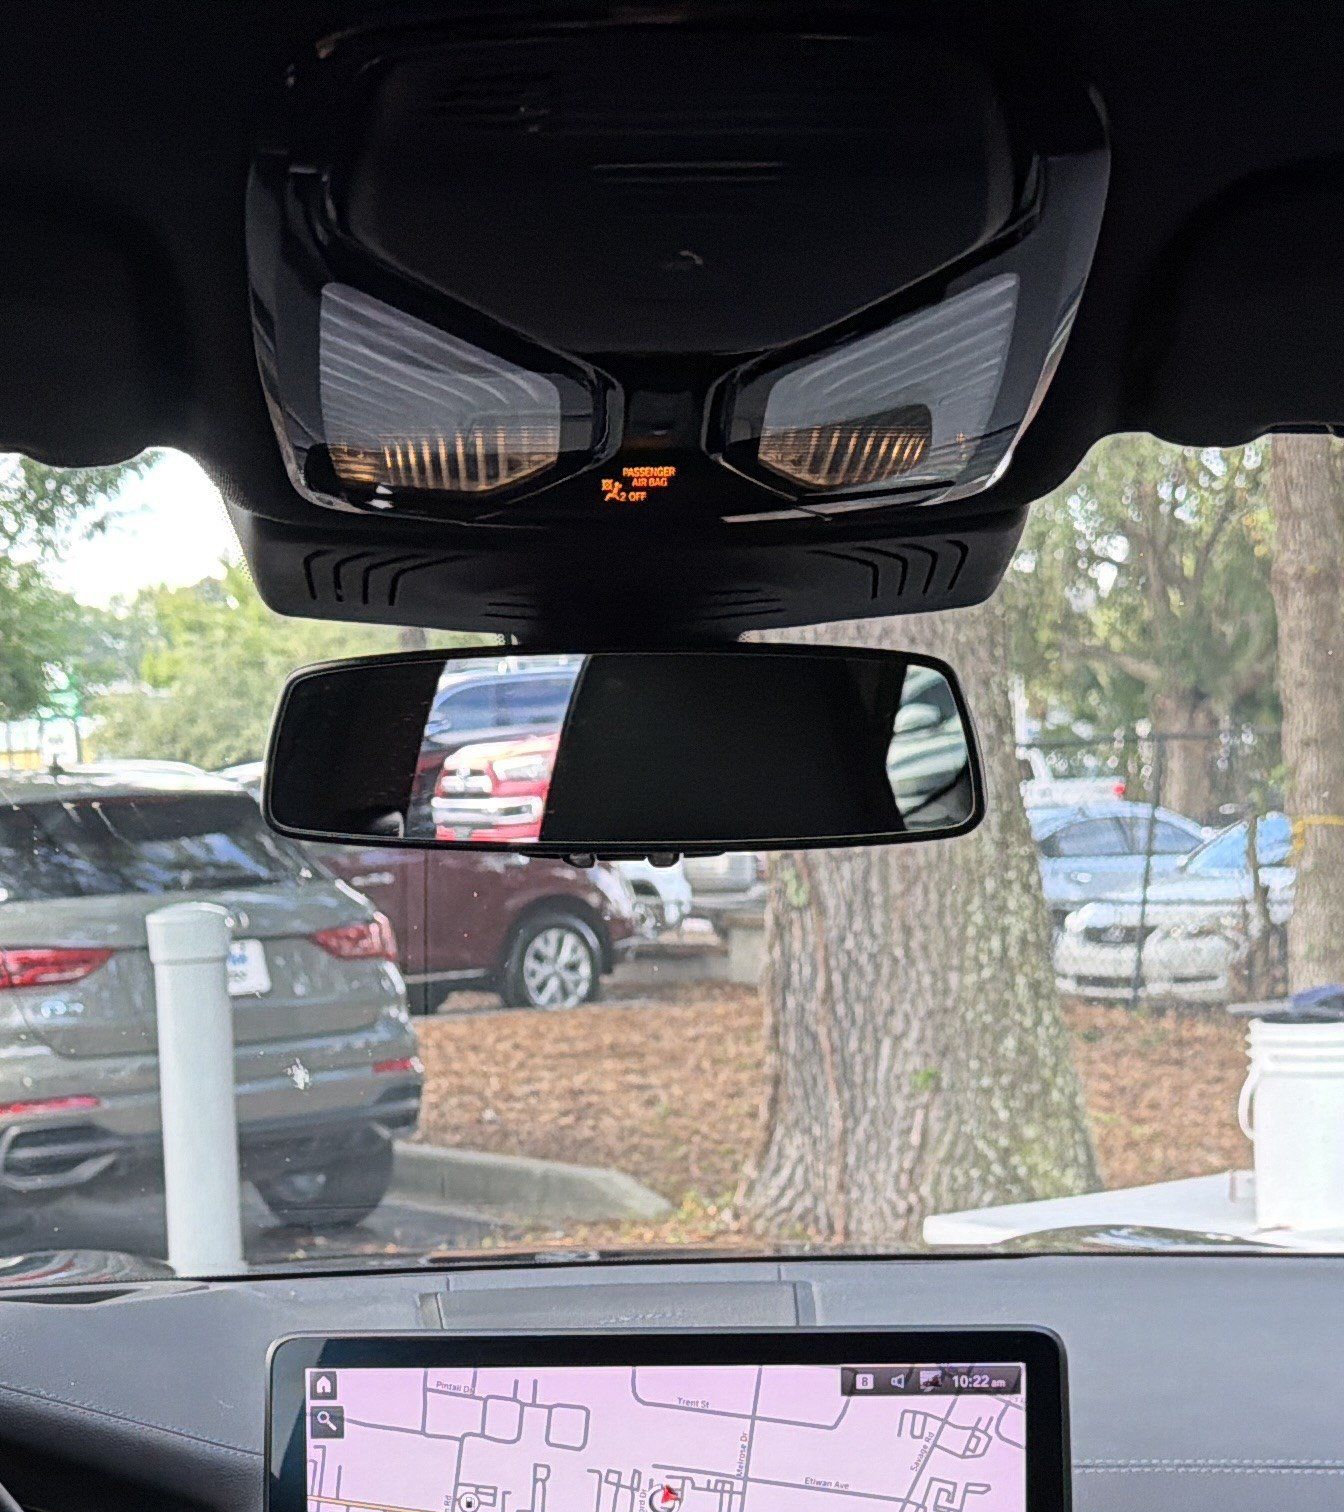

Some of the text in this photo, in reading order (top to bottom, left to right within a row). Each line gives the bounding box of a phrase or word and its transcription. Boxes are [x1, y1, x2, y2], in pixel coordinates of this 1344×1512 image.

[622, 466, 676, 477] PASSENGER
[632, 478, 668, 487] AIR BAG
[628, 492, 646, 501] OFF
[951, 1374, 1006, 1388] 10:22 am
[677, 1396, 701, 1408] Trent
[910, 1444, 929, 1472] Savage
[804, 1476, 850, 1489] Etiwan Ave
[444, 1495, 452, 1506] Rd
